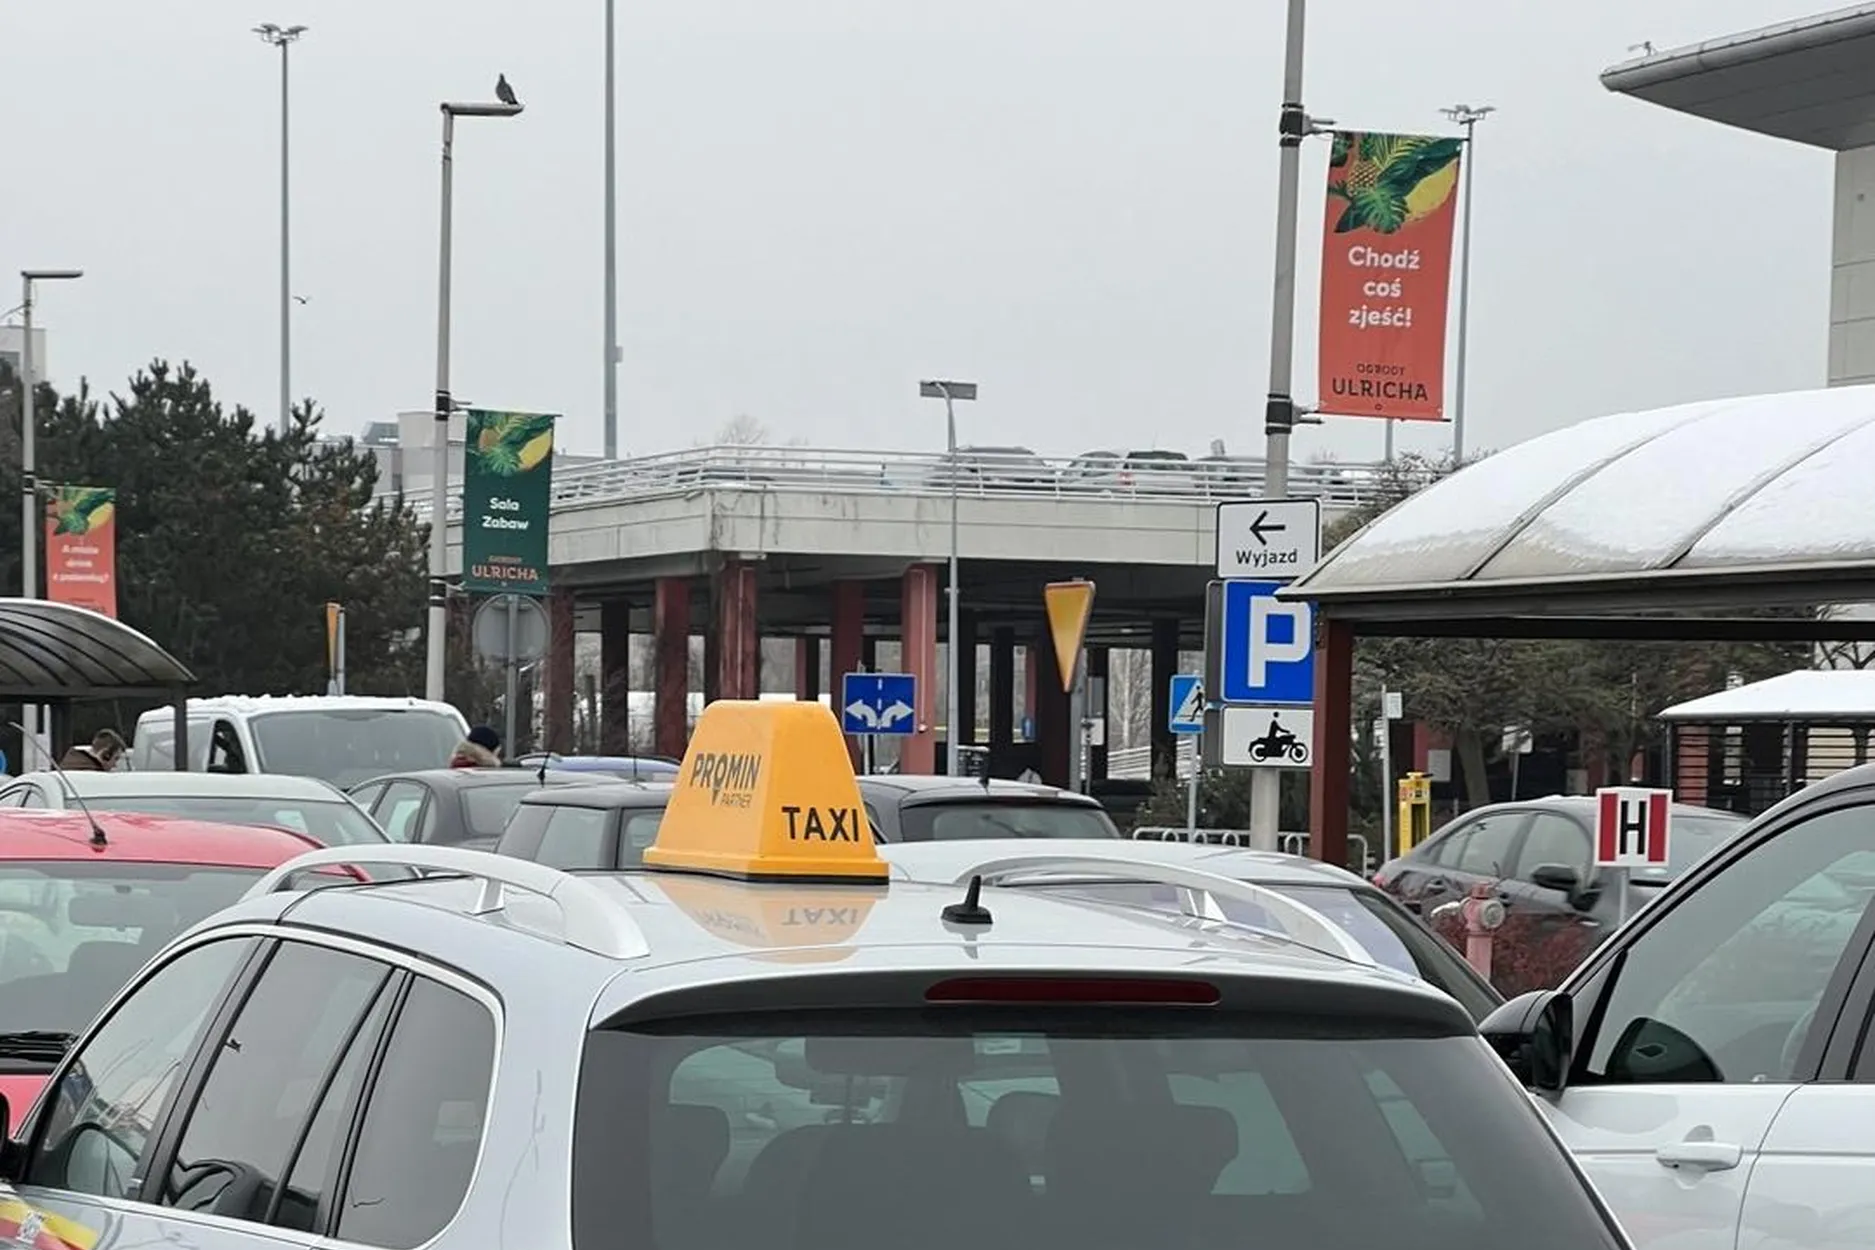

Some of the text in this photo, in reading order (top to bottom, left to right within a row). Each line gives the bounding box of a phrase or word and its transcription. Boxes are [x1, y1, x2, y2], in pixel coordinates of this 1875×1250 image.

[1348, 246, 1420, 269] Chodź
[1363, 277, 1402, 297] coś
[1349, 304, 1412, 329] zjeść!
[1332, 377, 1428, 401] ULRICHA
[489, 497, 520, 511] Sala
[482, 515, 529, 530] Zabaw
[1236, 550, 1297, 567] Wyjazd
[471, 564, 538, 580] ULRICHA
[1248, 595, 1311, 687] P
[690, 753, 762, 789] PROMIN
[782, 806, 859, 842] TAXI
[1620, 801, 1647, 854] H
